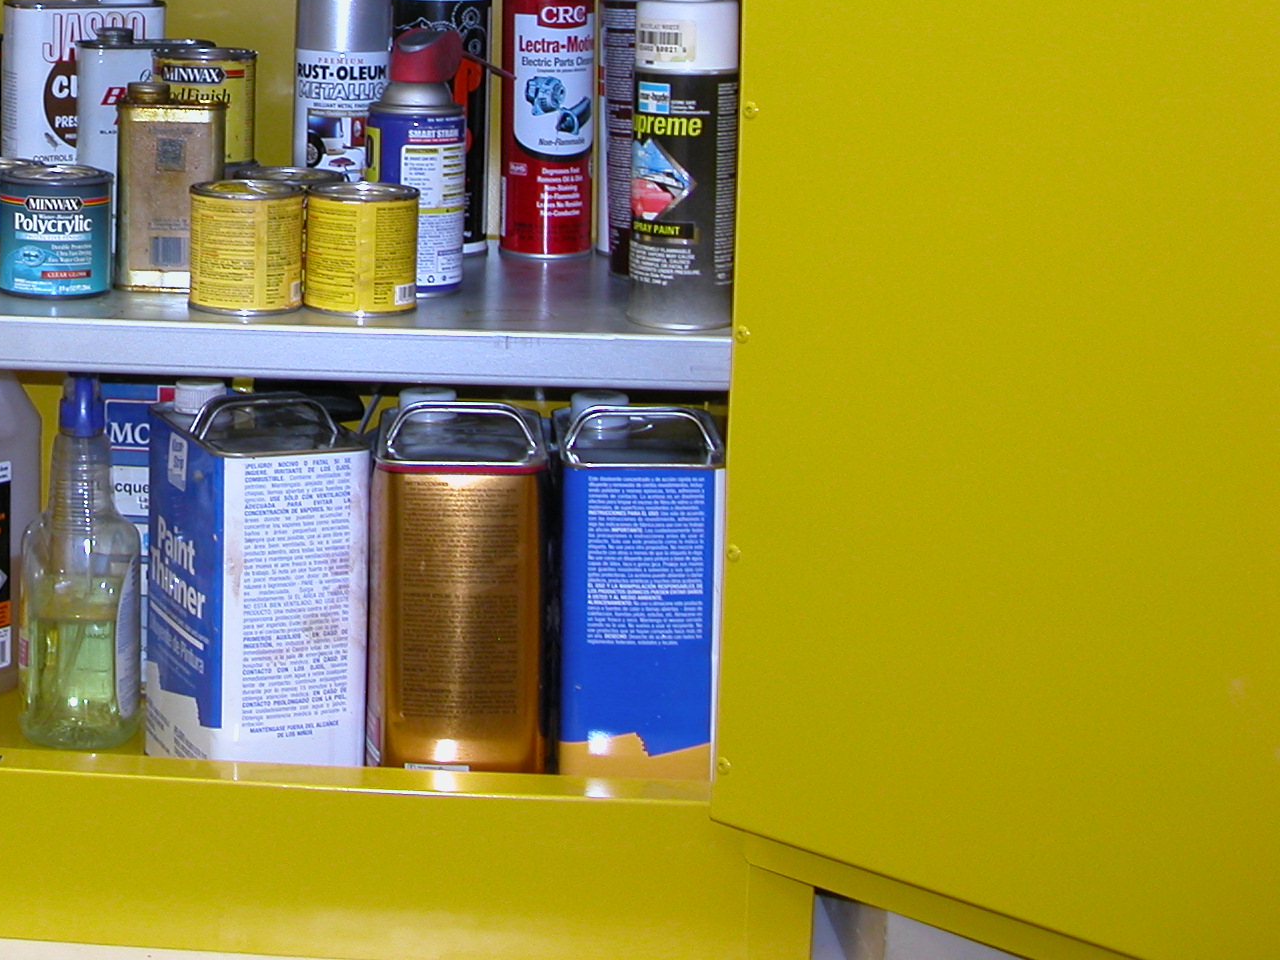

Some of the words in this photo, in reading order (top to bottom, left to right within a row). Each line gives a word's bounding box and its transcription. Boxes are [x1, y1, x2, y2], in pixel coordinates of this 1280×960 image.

[540, 5, 586, 24] CRC
[318, 57, 365, 65] PREMIUM
[522, 56, 552, 67] Electric
[554, 57, 575, 67] Parts
[163, 66, 220, 83] MINWAX
[298, 62, 387, 81] RUST-OLEUM
[298, 81, 387, 101] METALLIC
[408, 129, 435, 138] SMART
[538, 138, 585, 146] Non-Flammable
[33, 154, 73, 162] CONTROLS
[28, 198, 79, 210] MINWAX
[14, 212, 92, 234] Polycrylic
[653, 224, 680, 235] PAINT
[157, 514, 195, 575] Paint
[150, 545, 206, 619] Thinner
